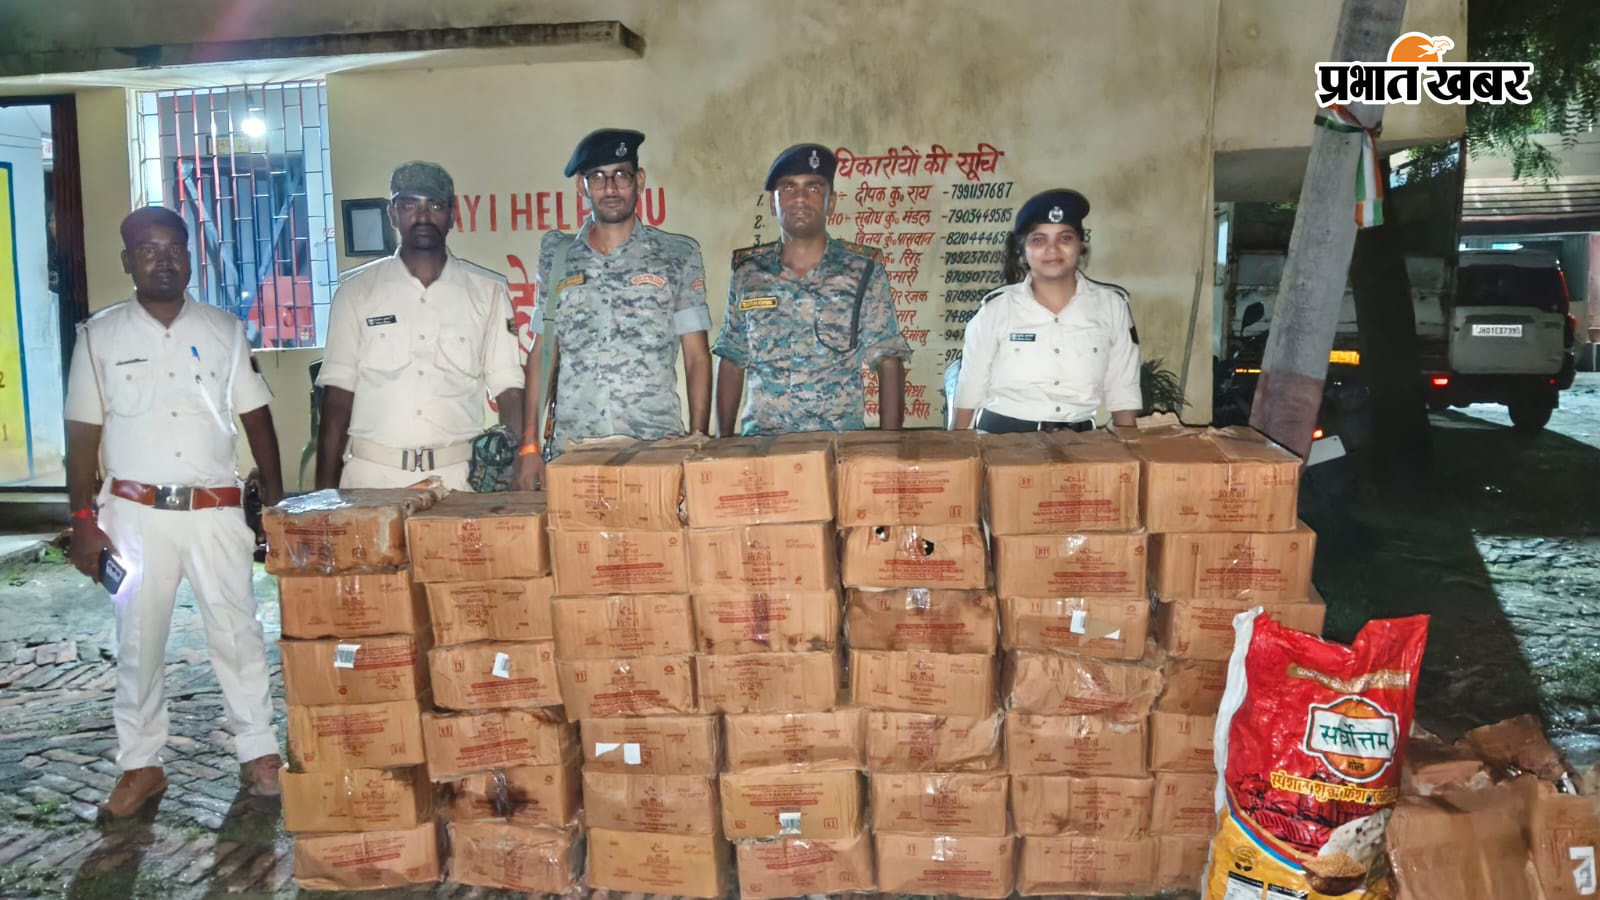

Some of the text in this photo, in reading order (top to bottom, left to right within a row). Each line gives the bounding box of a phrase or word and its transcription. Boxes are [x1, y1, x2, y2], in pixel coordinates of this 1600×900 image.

[835, 145, 922, 180] धिकारीयों
[923, 144, 954, 176] की
[855, 181, 887, 207] दीपक
[907, 185, 934, 205] राय
[489, 192, 497, 232] I
[902, 207, 933, 227] मंडल
[1319, 722, 1390, 750] सर्वोत्तम
